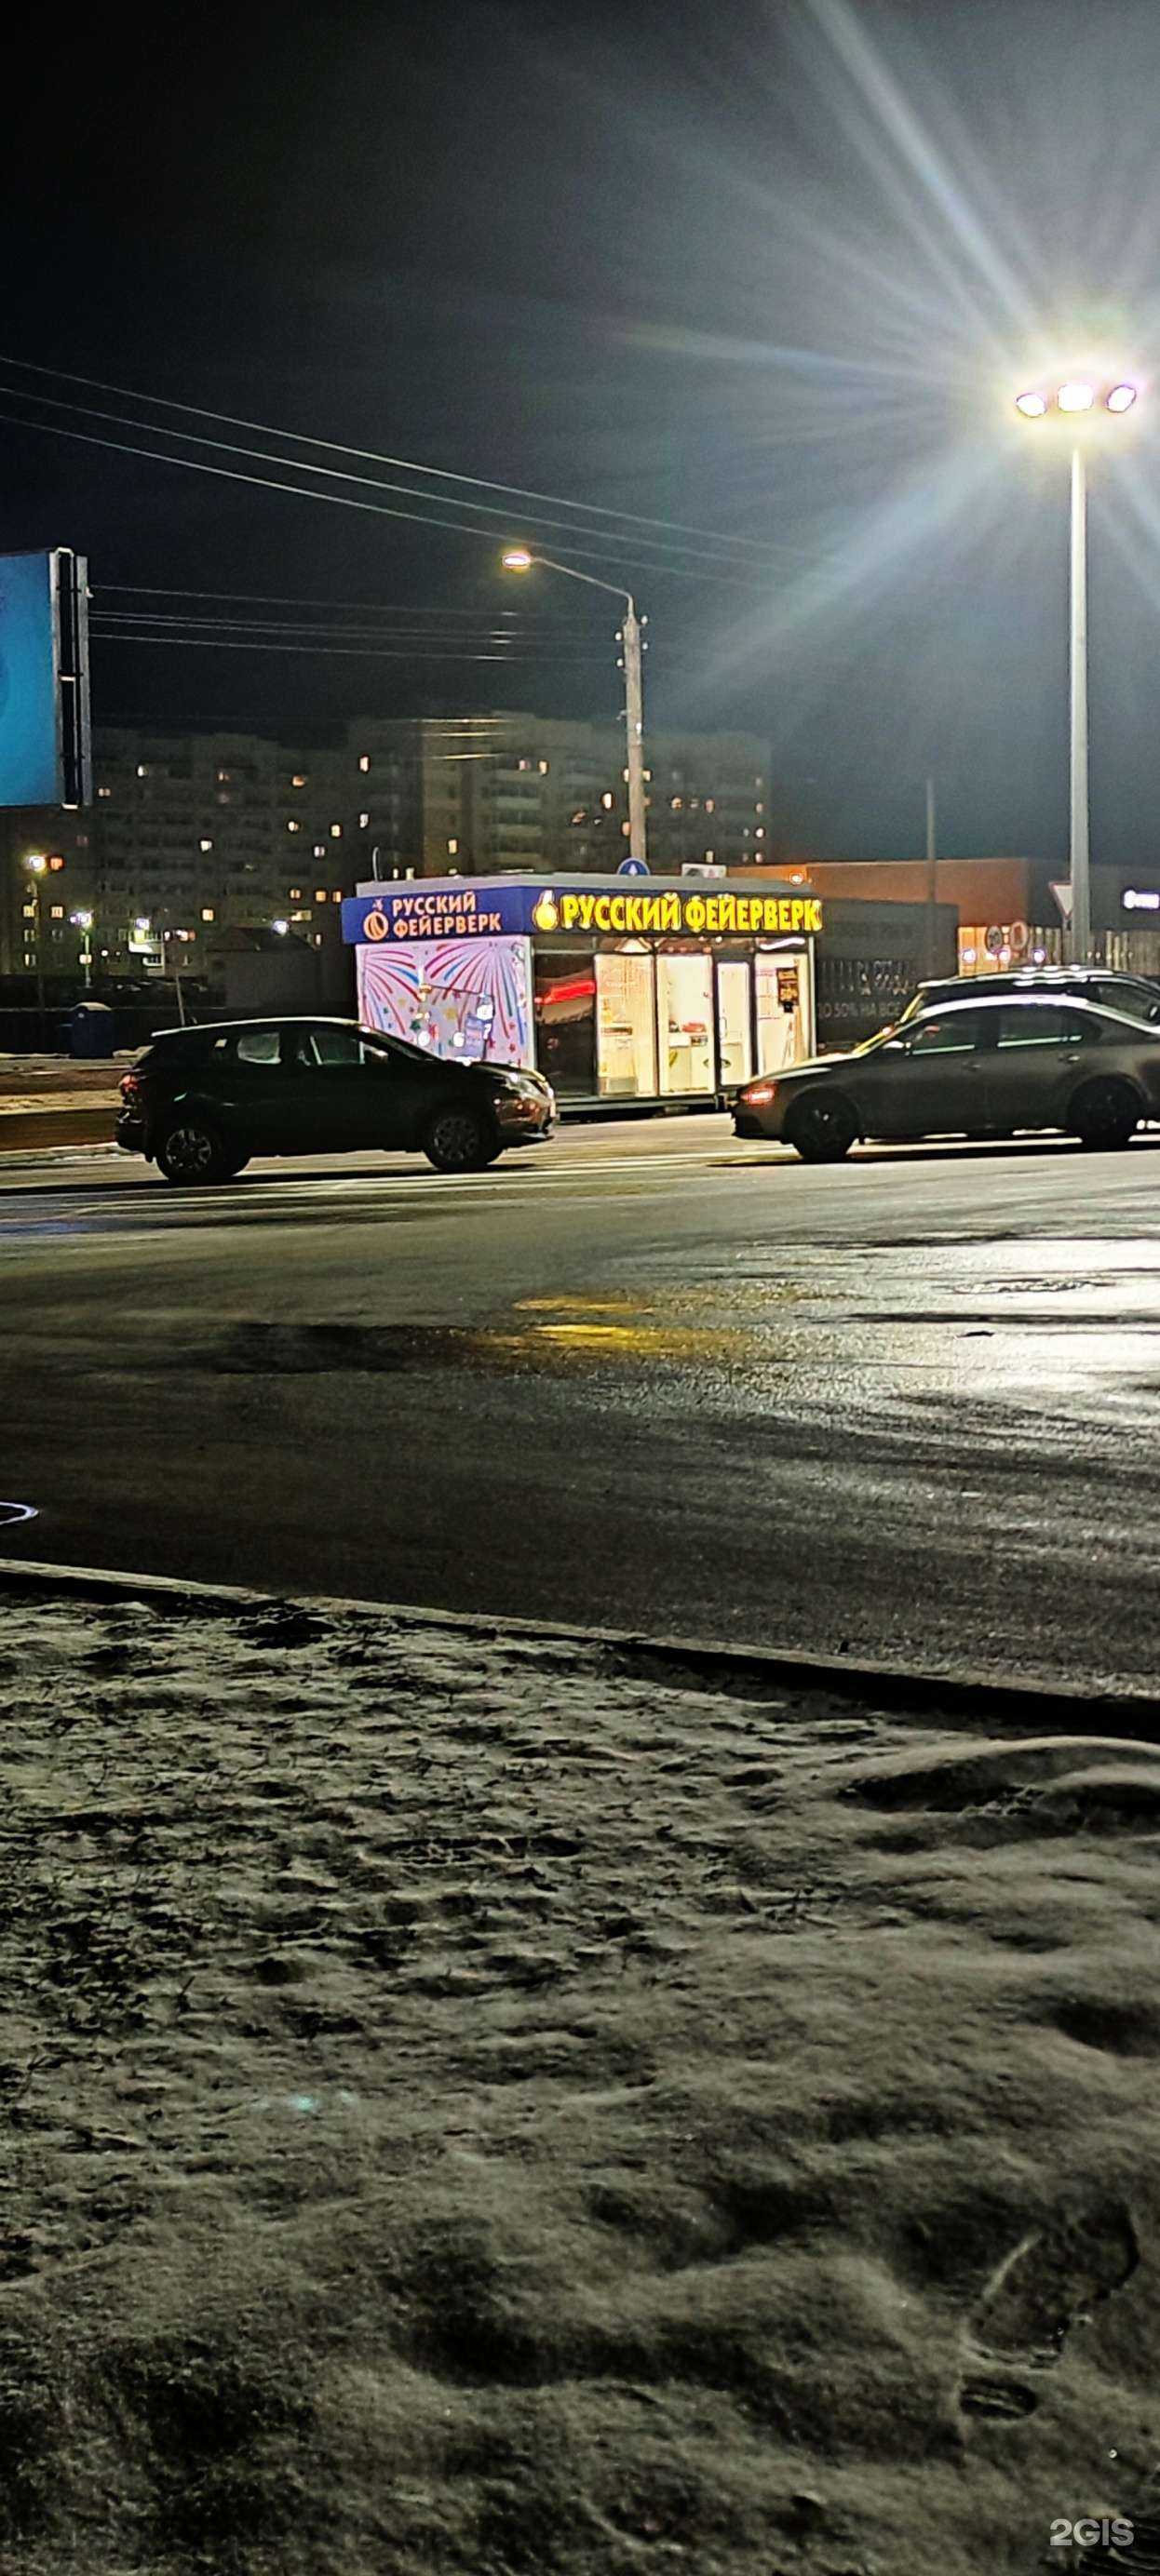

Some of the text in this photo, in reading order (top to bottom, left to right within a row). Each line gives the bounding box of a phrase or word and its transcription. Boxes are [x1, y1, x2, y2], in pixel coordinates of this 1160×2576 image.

[393, 891, 476, 917] РУССКИЙ
[560, 892, 822, 932] РУССКИЙ ФЕЙЕРВЕРК
[393, 913, 502, 938] ФЕЙЕРВЕРК
